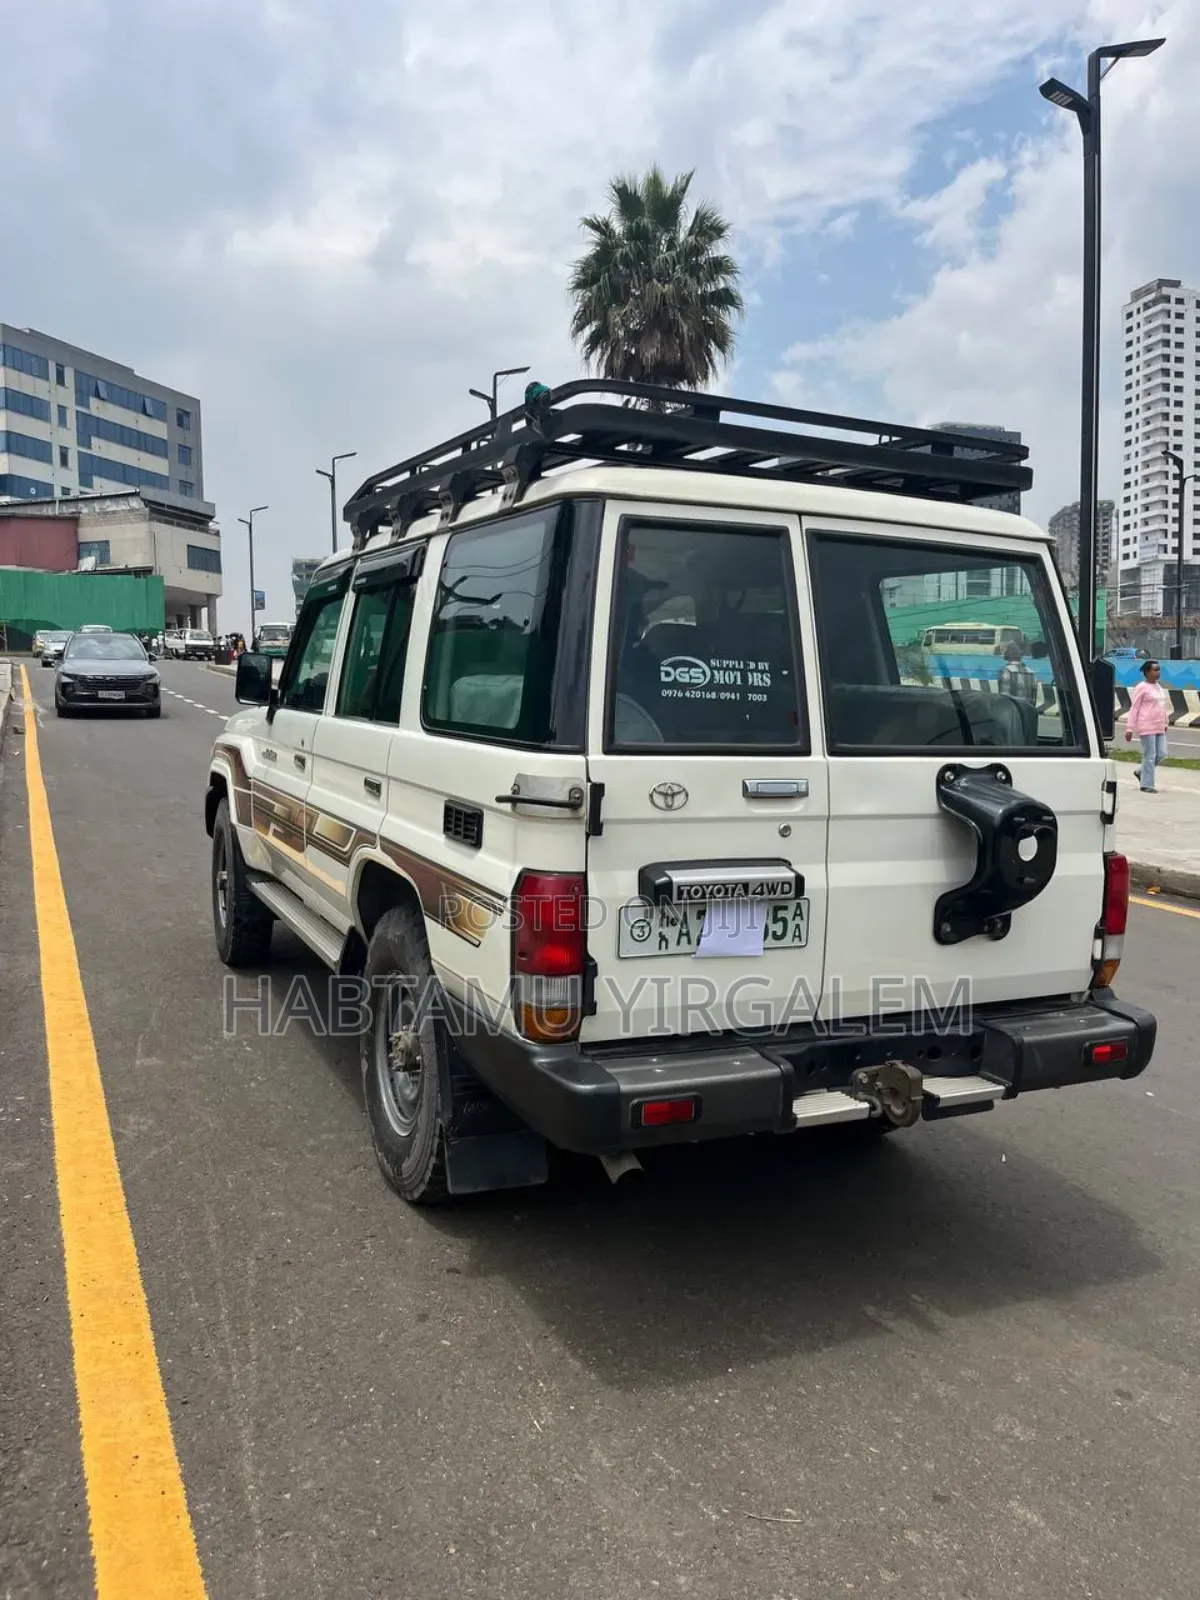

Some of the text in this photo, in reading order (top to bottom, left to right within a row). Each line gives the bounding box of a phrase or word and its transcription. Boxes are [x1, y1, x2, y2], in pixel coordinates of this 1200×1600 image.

[660, 665, 706, 683] DGS
[758, 661, 770, 671] BY
[680, 881, 793, 899] TOYOTA 4WD
